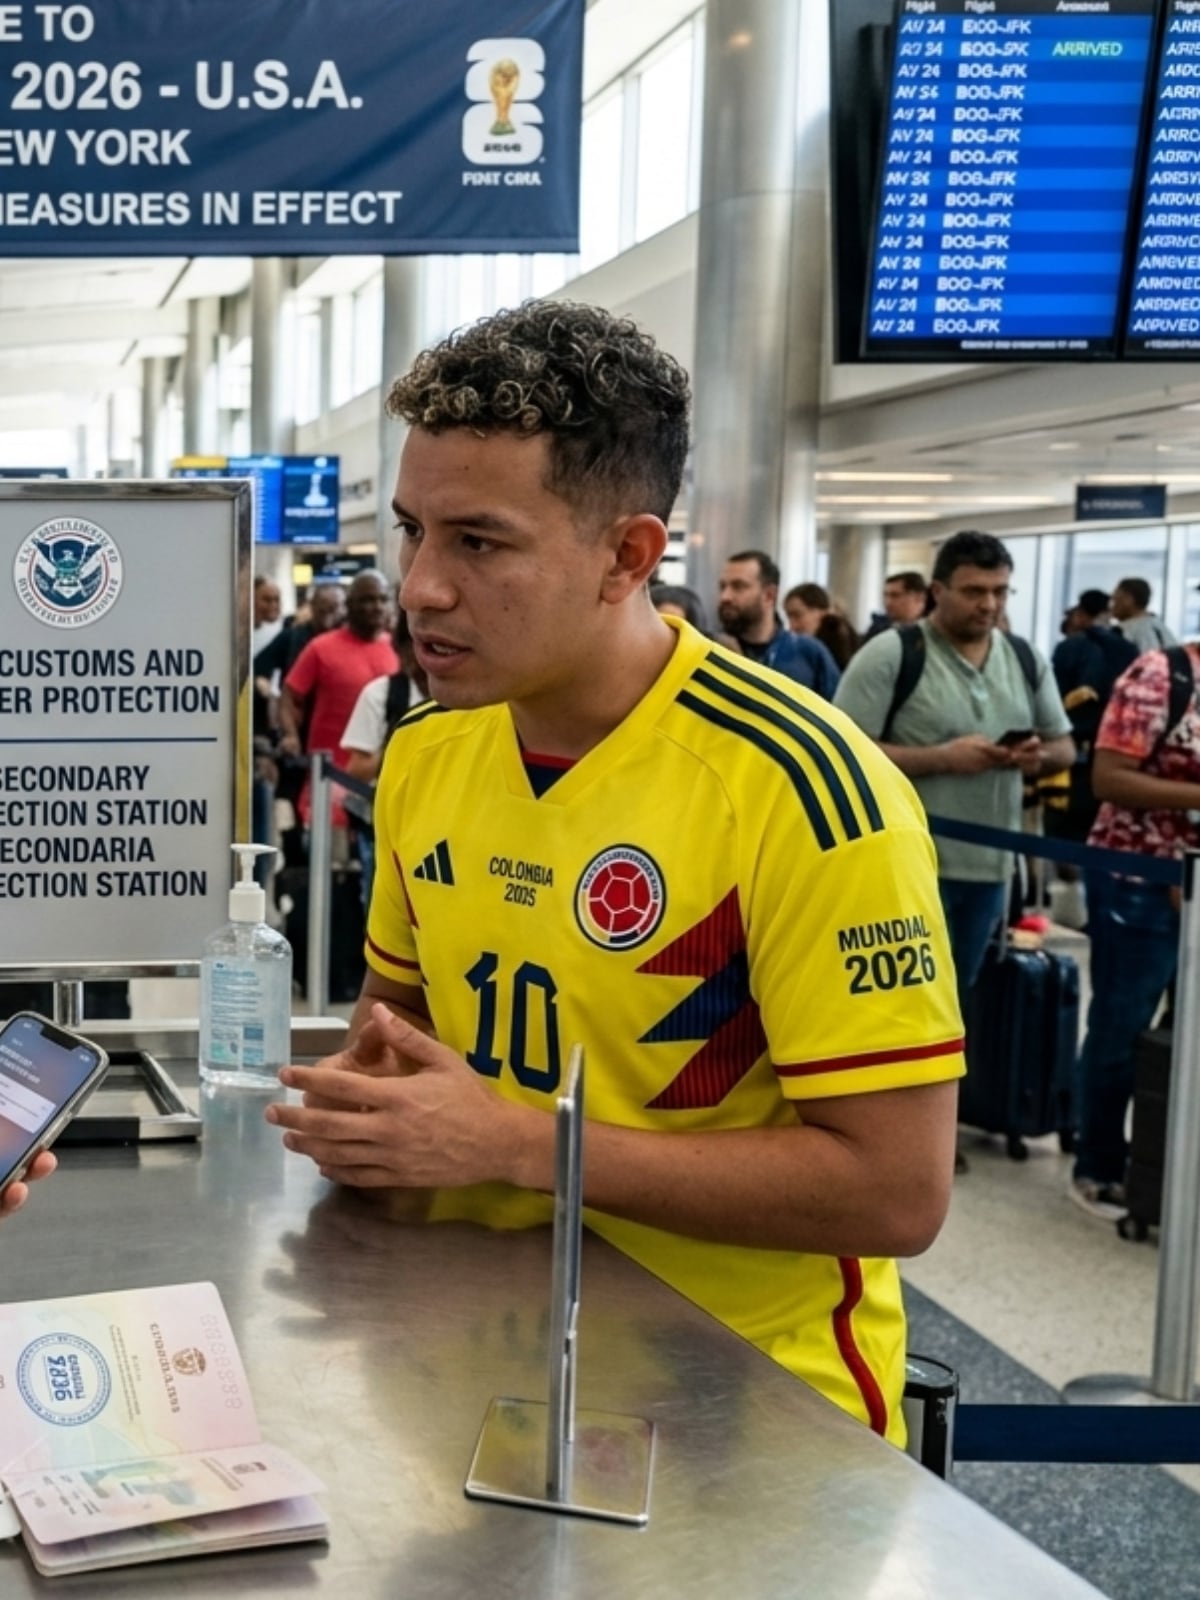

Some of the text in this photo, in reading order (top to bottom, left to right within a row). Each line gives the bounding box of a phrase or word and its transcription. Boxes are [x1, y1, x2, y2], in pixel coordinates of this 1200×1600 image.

[35, 5, 94, 41] TO
[1053, 41, 1123, 56] ARRIVED
[11, 62, 141, 109] 2026
[197, 60, 363, 109] U.S.A.
[66, 129, 190, 165] YORK
[203, 192, 239, 224] IN
[253, 191, 402, 224] EFFECT
[144, 650, 203, 676] AND
[43, 686, 219, 713] PROTECTION
[97, 800, 207, 826] STATION
[97, 871, 207, 897] STATION
[838, 915, 931, 952] MUNDIAL
[845, 943, 936, 995] 2026
[464, 951, 561, 1094] 10
